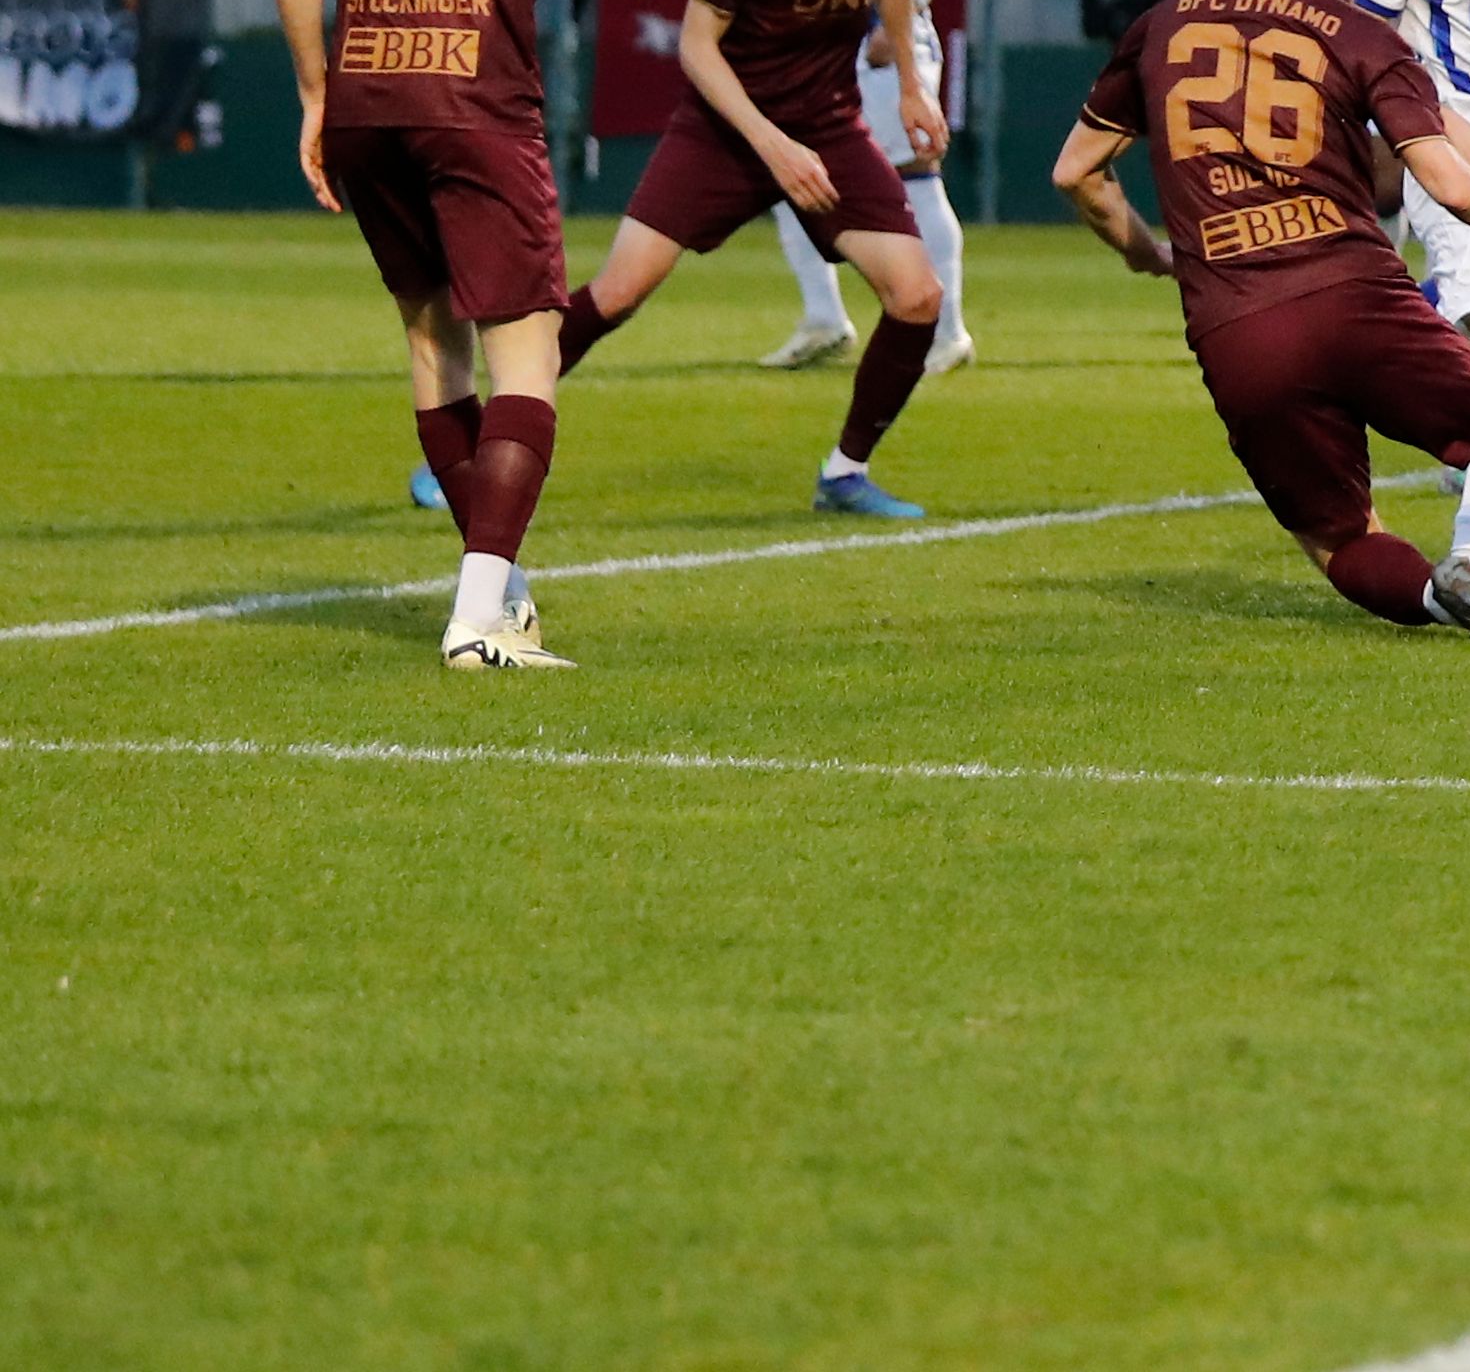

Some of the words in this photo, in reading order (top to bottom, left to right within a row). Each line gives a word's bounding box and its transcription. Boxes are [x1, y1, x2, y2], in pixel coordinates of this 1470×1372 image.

[377, 30, 475, 74] BBK
[1165, 22, 1329, 168] 26
[1240, 197, 1345, 247] BBK
